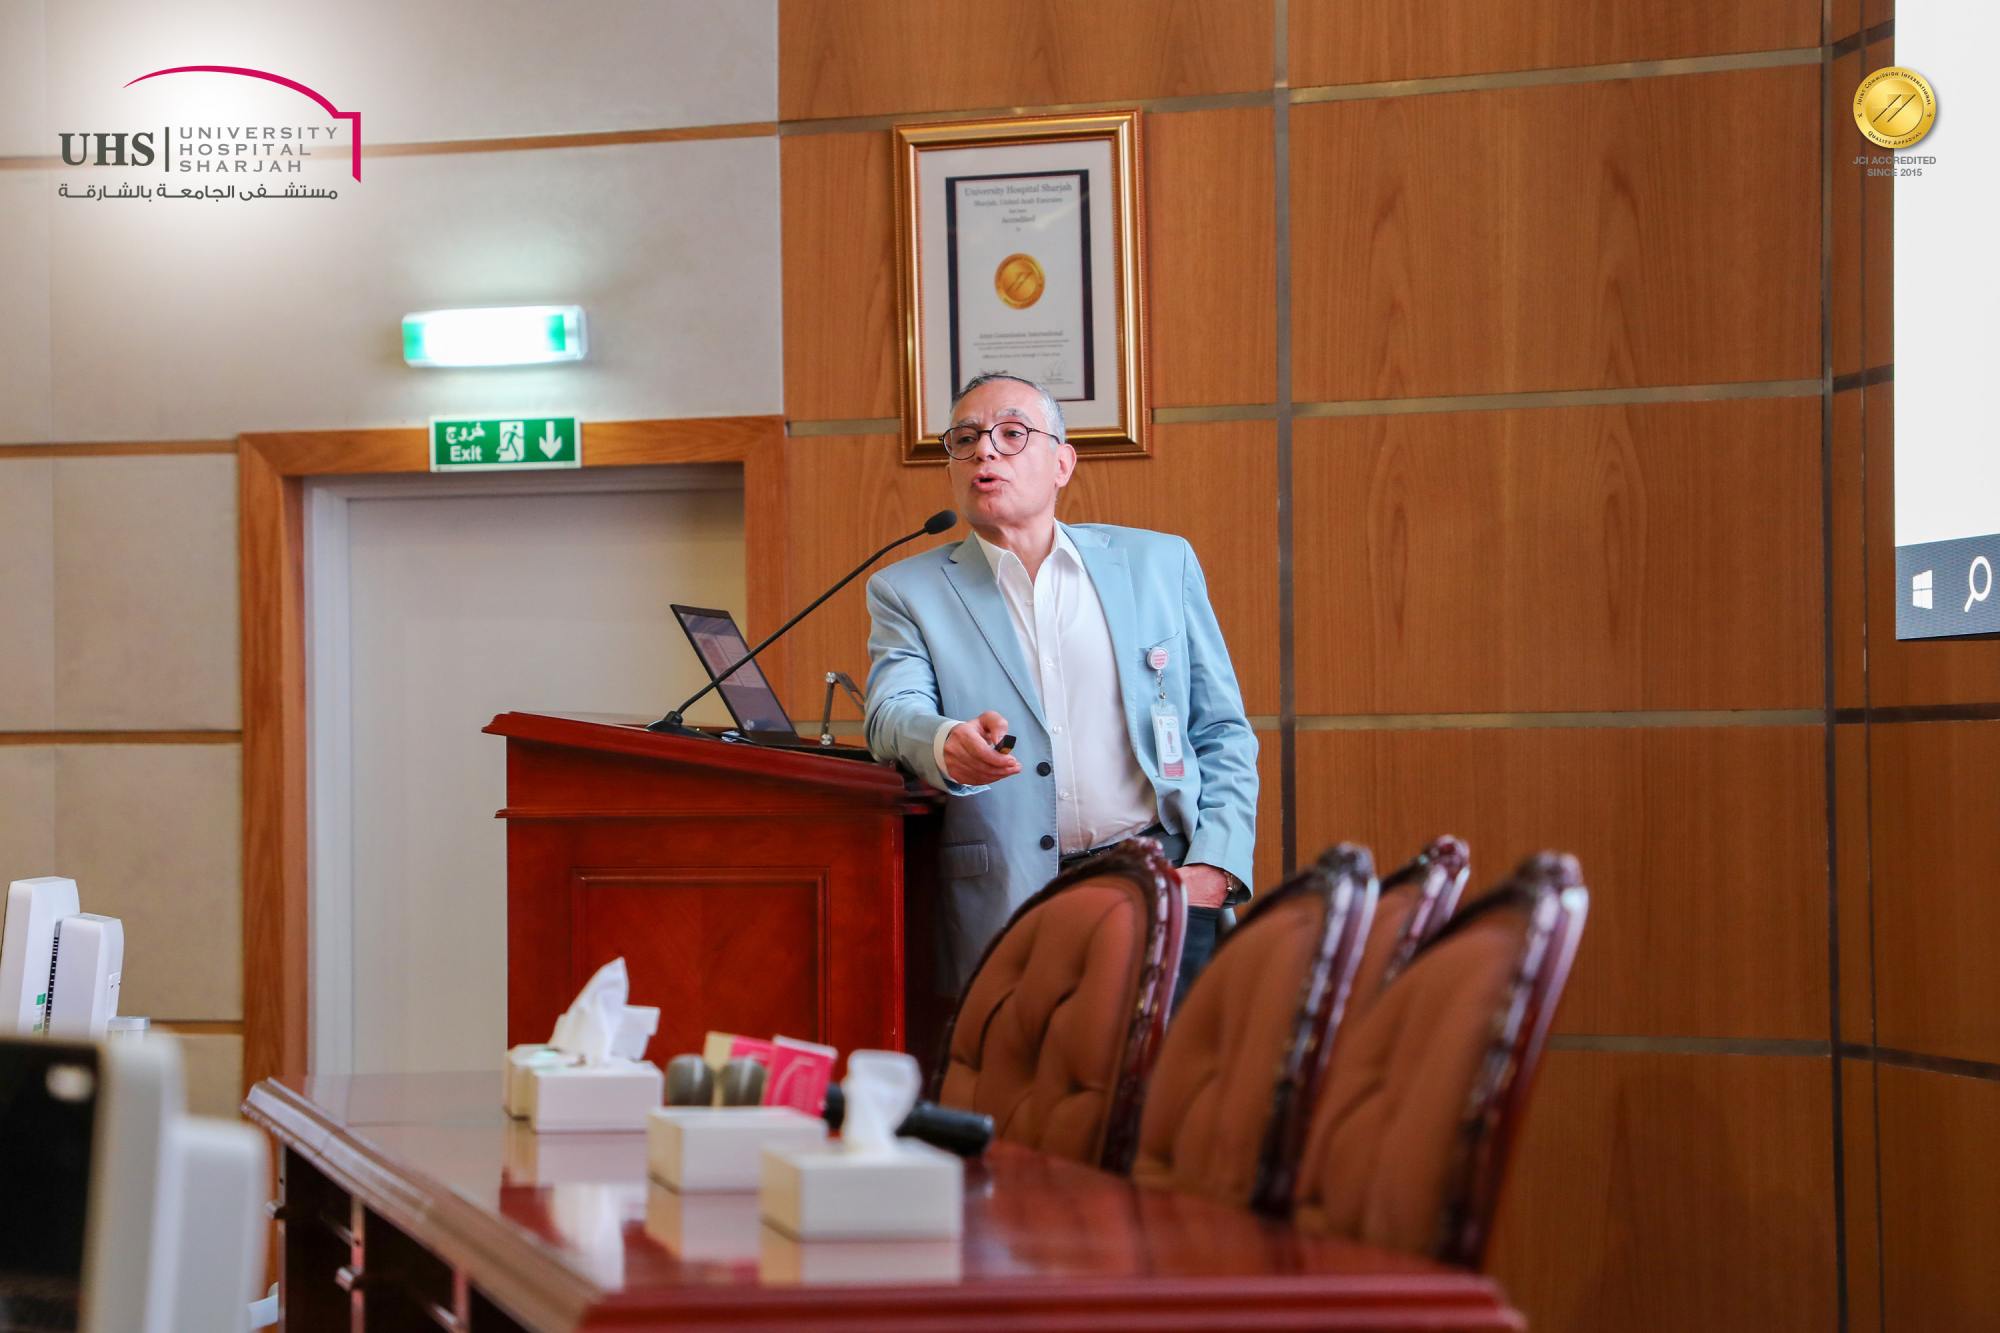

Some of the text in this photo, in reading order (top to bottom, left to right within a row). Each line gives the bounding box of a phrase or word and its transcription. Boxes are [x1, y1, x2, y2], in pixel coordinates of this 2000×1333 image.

[964, 182, 1073, 197] University Hospital Sharjah
[446, 421, 486, 444] خروج
[450, 445, 483, 461] Exit
